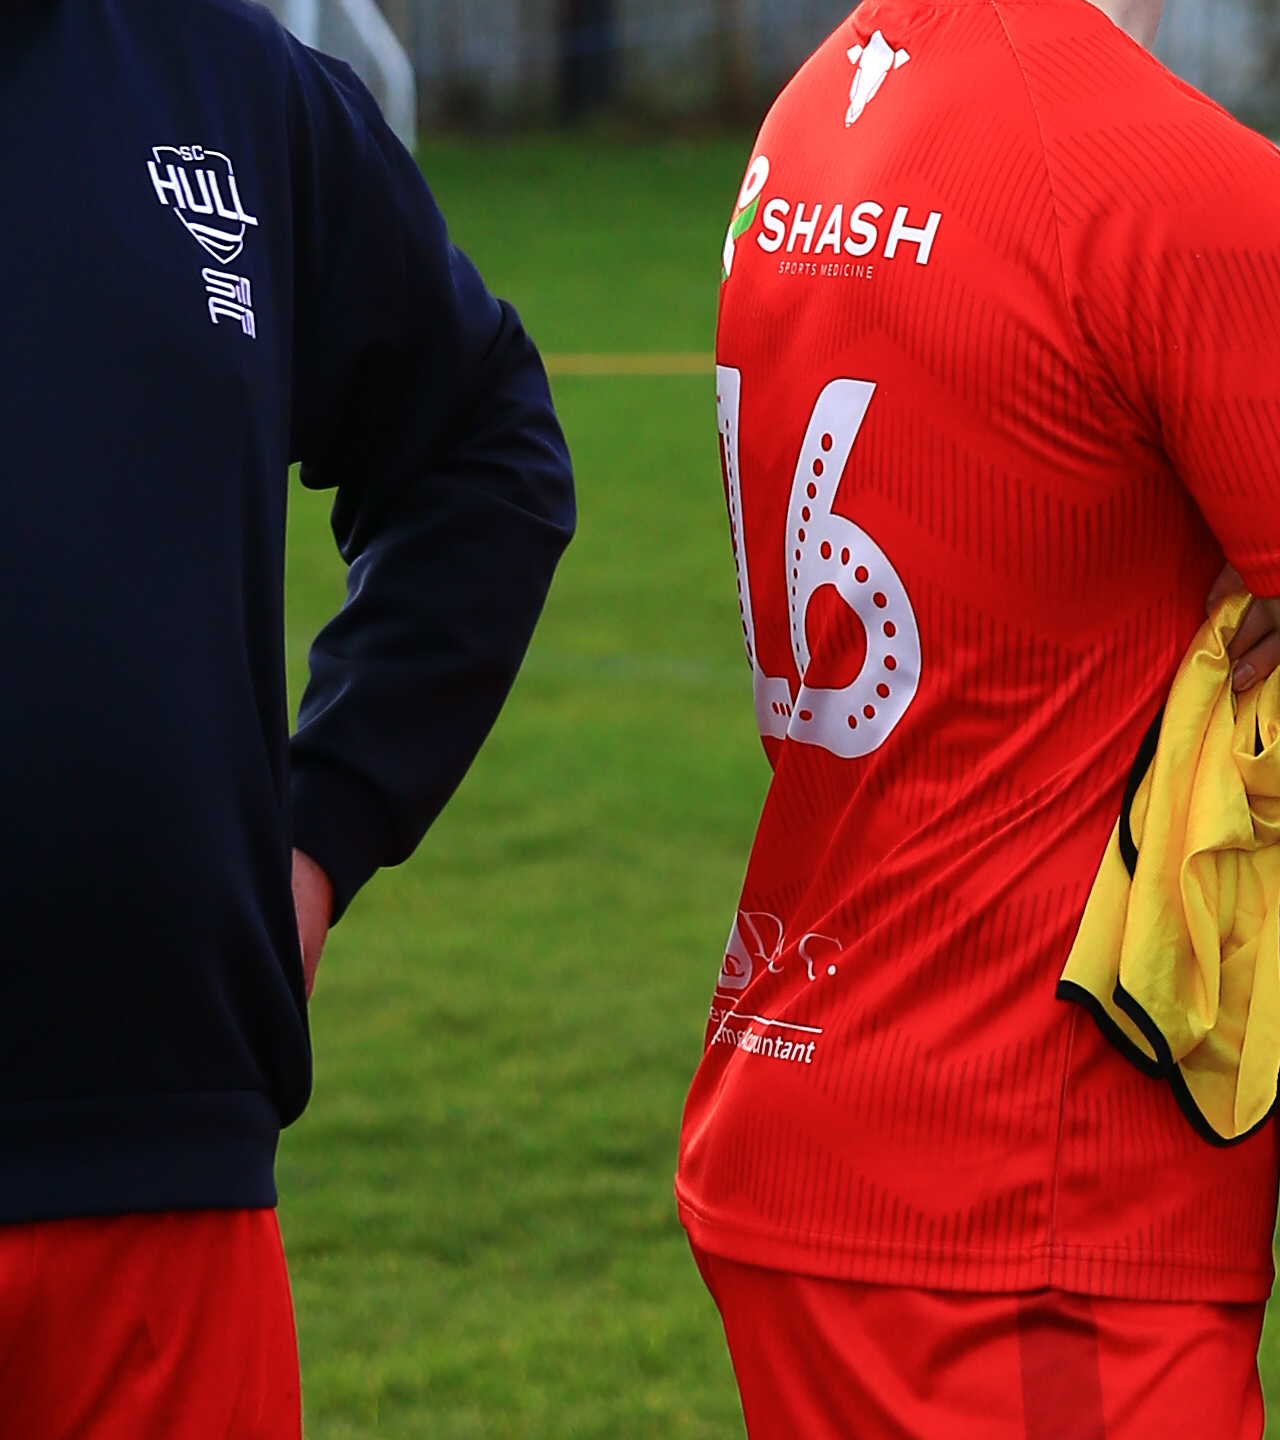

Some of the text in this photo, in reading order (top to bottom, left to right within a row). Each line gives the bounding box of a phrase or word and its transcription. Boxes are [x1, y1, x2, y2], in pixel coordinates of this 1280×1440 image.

[179, 146, 205, 161] SC
[147, 160, 259, 226] HULL
[756, 197, 943, 266] SHASH
[778, 261, 874, 280] SPORTS MEDICINE
[715, 363, 922, 760] 16
